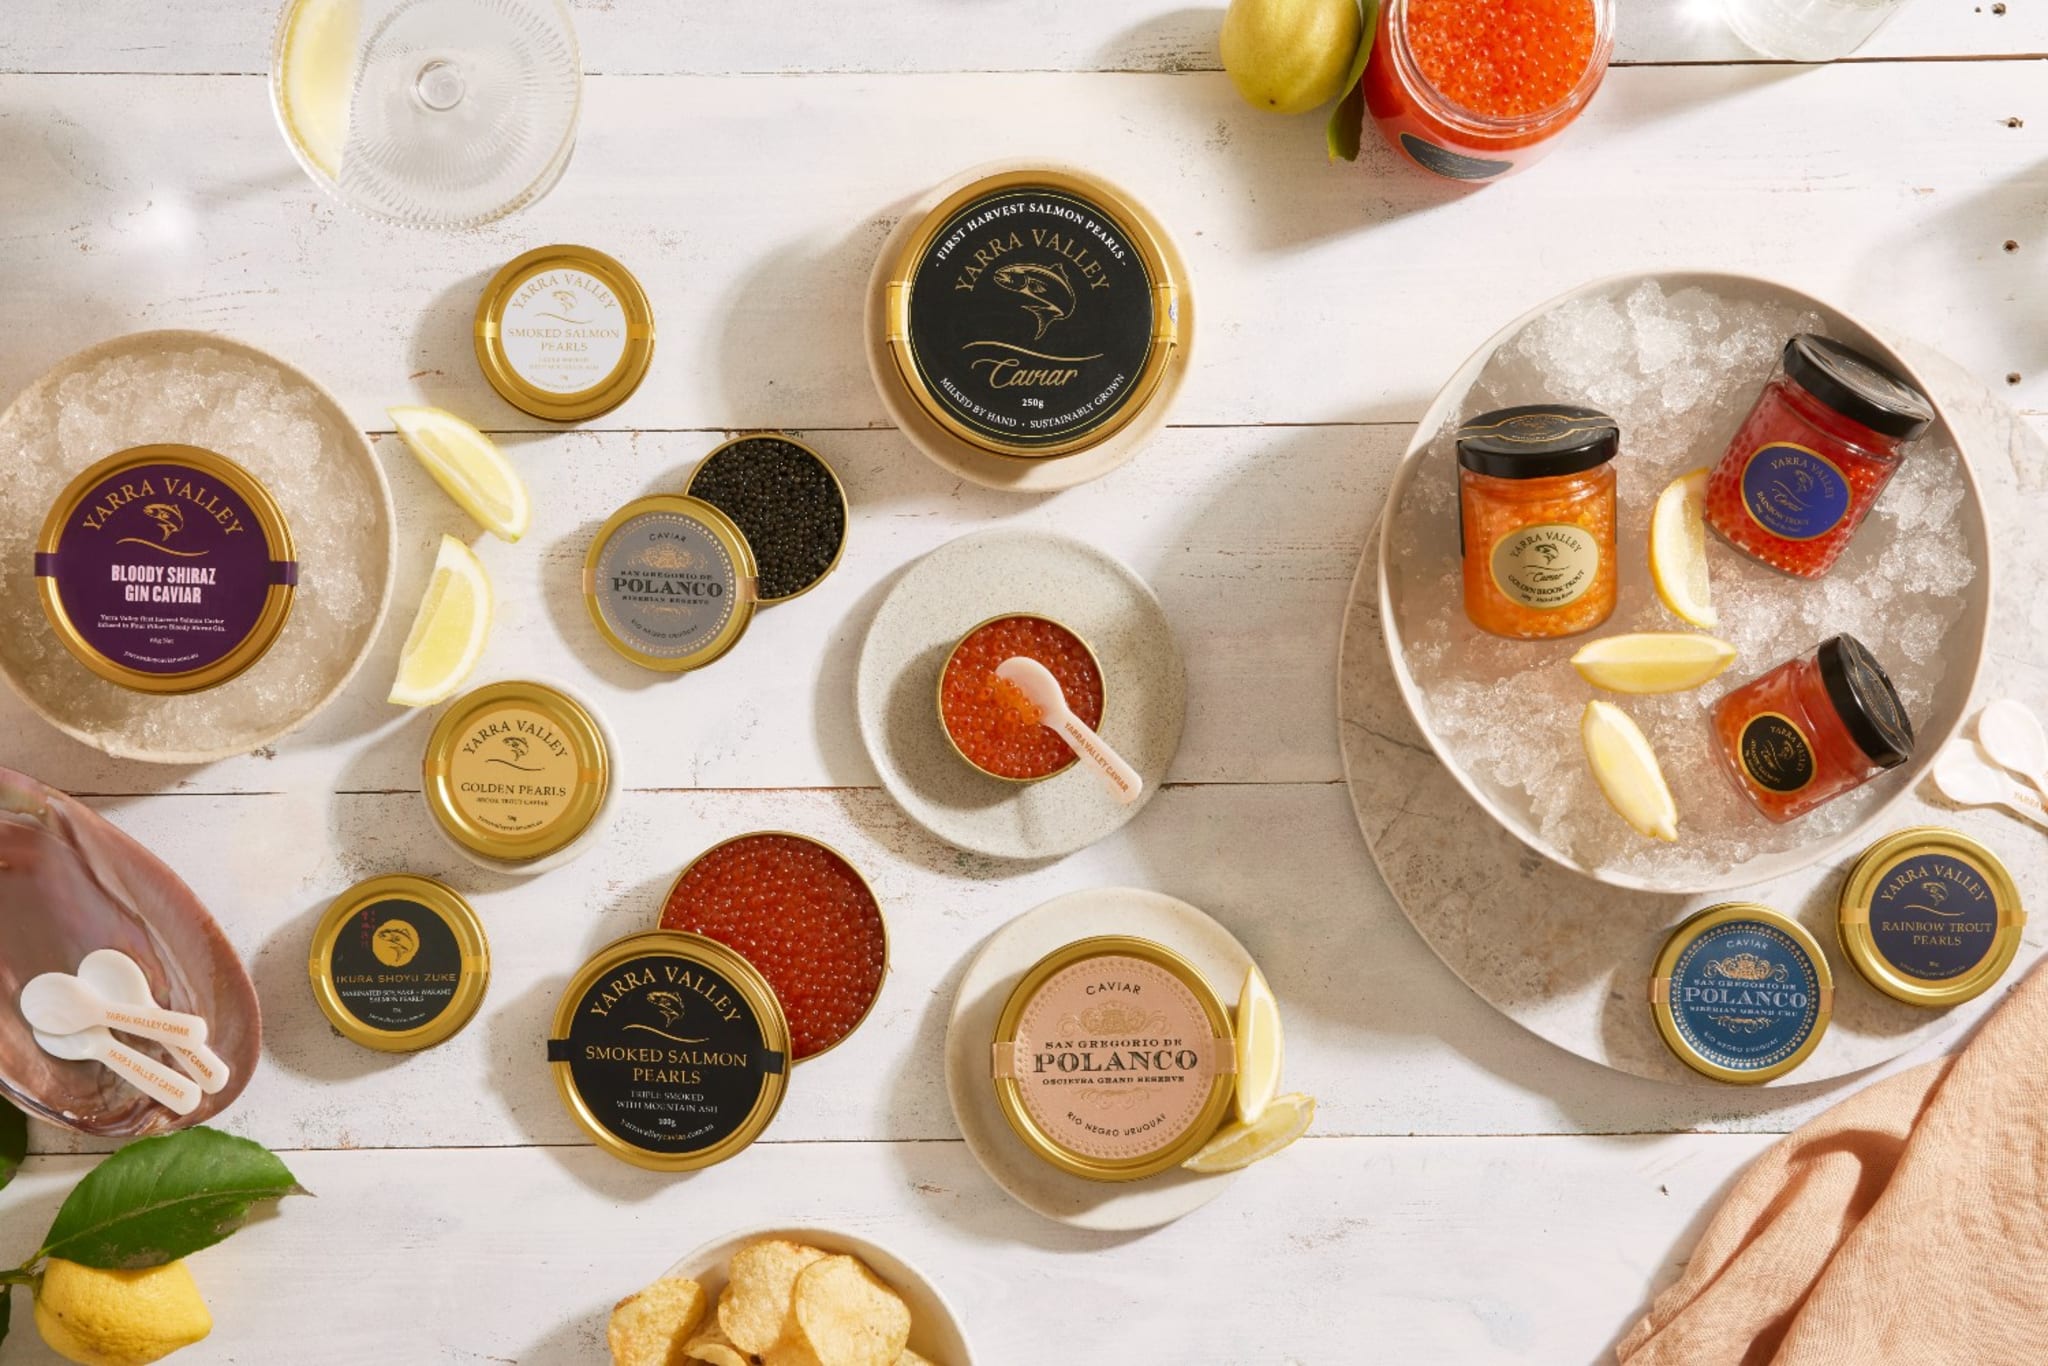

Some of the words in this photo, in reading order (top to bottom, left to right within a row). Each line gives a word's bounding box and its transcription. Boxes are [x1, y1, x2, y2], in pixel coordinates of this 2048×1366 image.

[938, 227, 964, 260] FIRST
[967, 204, 1025, 231] HARVEST
[1029, 204, 1083, 223] SALMON
[1086, 220, 1125, 259] PEARLS
[955, 231, 1024, 292] YARRA
[1032, 229, 1109, 290] VALLEY
[512, 276, 560, 310] YARRA
[564, 274, 617, 309] VALLEY
[508, 328, 561, 338] SMOKED
[565, 329, 619, 338] SALMON
[541, 343, 588, 351] PEARLS
[971, 359, 1078, 389] Caviar
[940, 378, 973, 409] MILKED
[973, 403, 985, 416] BY
[987, 410, 1016, 427] HAND
[1030, 403, 1094, 428] SUSTAINABLY
[1094, 373, 1125, 405] GROWN
[1022, 398, 1044, 409] 250g
[1771, 457, 1807, 469] YARRA
[83, 479, 155, 530] YARRA
[163, 478, 243, 535] VALLEY
[650, 532, 686, 543] CAVIAR
[1510, 532, 1542, 557] YARRA
[1546, 531, 1582, 552] VALLEY
[111, 565, 164, 583] BLOODY
[167, 566, 216, 585] SHIRAZ
[125, 585, 150, 602] GIN
[152, 585, 201, 604] CAVIAR
[612, 578, 723, 597] POLANCO
[463, 721, 511, 755] YARRA
[517, 720, 567, 758] VALLEY
[1065, 723, 1085, 747] YARRA
[1084, 742, 1108, 768] VALLEY
[1105, 765, 1128, 792] CAVIAR
[461, 783, 515, 794] GOLDEN
[519, 785, 566, 796] PEARLS
[1881, 866, 1928, 902] YARRA
[1934, 864, 1988, 902] VALLEY
[1882, 922, 1945, 932] RAINBOW
[1950, 923, 1992, 932] TROUT
[1726, 940, 1768, 950] CAVIAR
[1913, 936, 1962, 946] PEARLS
[337, 975, 373, 983] IKURA
[379, 975, 418, 983] SHOYU
[424, 973, 456, 982] ZUKE
[1718, 980, 1779, 989] GREGORIO
[591, 968, 656, 1018] YARRA
[664, 966, 741, 1022] VALLEY
[1087, 982, 1141, 995] CAVIAR
[1683, 987, 1807, 1008] POLANCO
[106, 1011, 131, 1023] YARRA
[132, 1017, 161, 1029] VALLEY
[162, 1022, 190, 1036] CAVIAR
[1046, 1041, 1073, 1049] SAN
[1078, 1039, 1158, 1048] GREGORIO
[586, 1046, 663, 1063] SMOKED
[668, 1051, 747, 1067] SALMON
[1033, 1050, 1198, 1073] POLANCO
[108, 1050, 131, 1066] YARRA
[132, 1064, 159, 1082] VALLEY
[158, 1079, 184, 1098] CAVIAR
[191, 1055, 212, 1079] CAVIAR
[633, 1068, 700, 1084] PEARLS
[616, 1100, 641, 1109] WITH
[644, 1102, 695, 1112] MOUNTAIN
[632, 1090, 660, 1099] TRIPLE
[665, 1092, 704, 1102] SMOKED
[1067, 1112, 1081, 1125] RIO
[1085, 1123, 1119, 1137] NEGRO
[1124, 1113, 1167, 1136] URUGUAY
